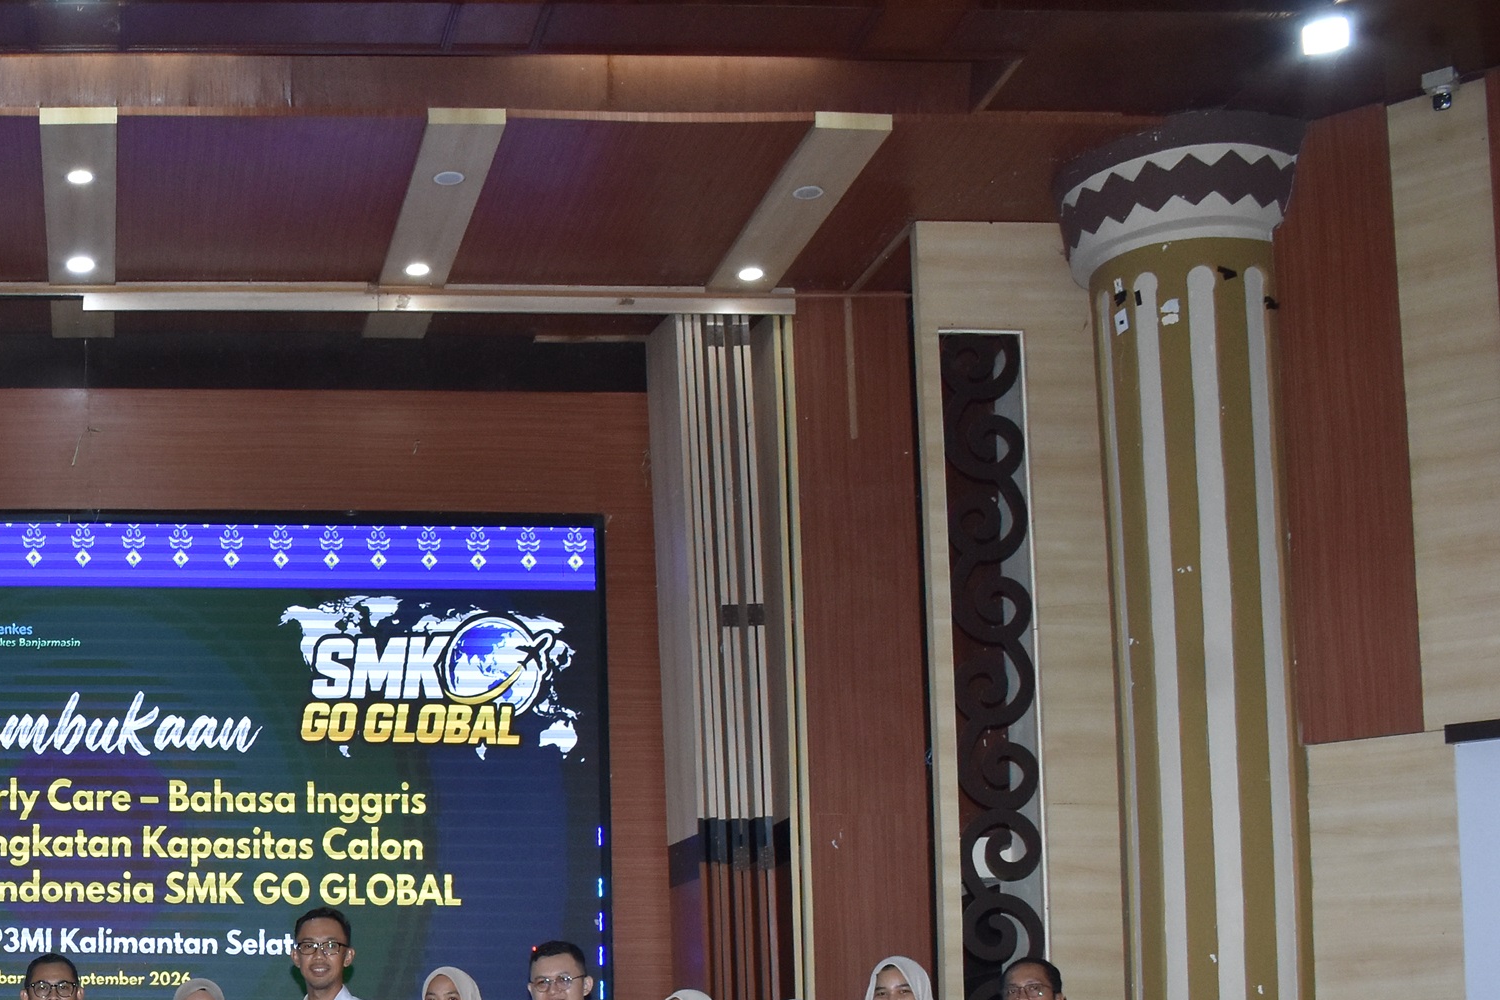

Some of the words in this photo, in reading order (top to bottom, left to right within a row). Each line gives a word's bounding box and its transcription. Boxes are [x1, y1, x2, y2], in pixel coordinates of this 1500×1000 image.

[19, 638, 81, 649] Banjarmasin
[311, 636, 451, 699] SMK
[300, 702, 358, 741] GO
[363, 703, 520, 745] GLOBAL
[47, 778, 131, 812] Care
[168, 779, 296, 814] Bahasa
[306, 780, 427, 823] Inggris
[142, 826, 314, 867] Kapasitas
[322, 827, 424, 861] Calon
[164, 871, 245, 905] SMK
[253, 872, 311, 906] GO
[319, 873, 462, 906] GLOBAL
[60, 927, 218, 955] Kalimantan
[225, 929, 297, 956] Selat
[79, 971, 146, 988] ptember
[149, 971, 191, 986] 2026
